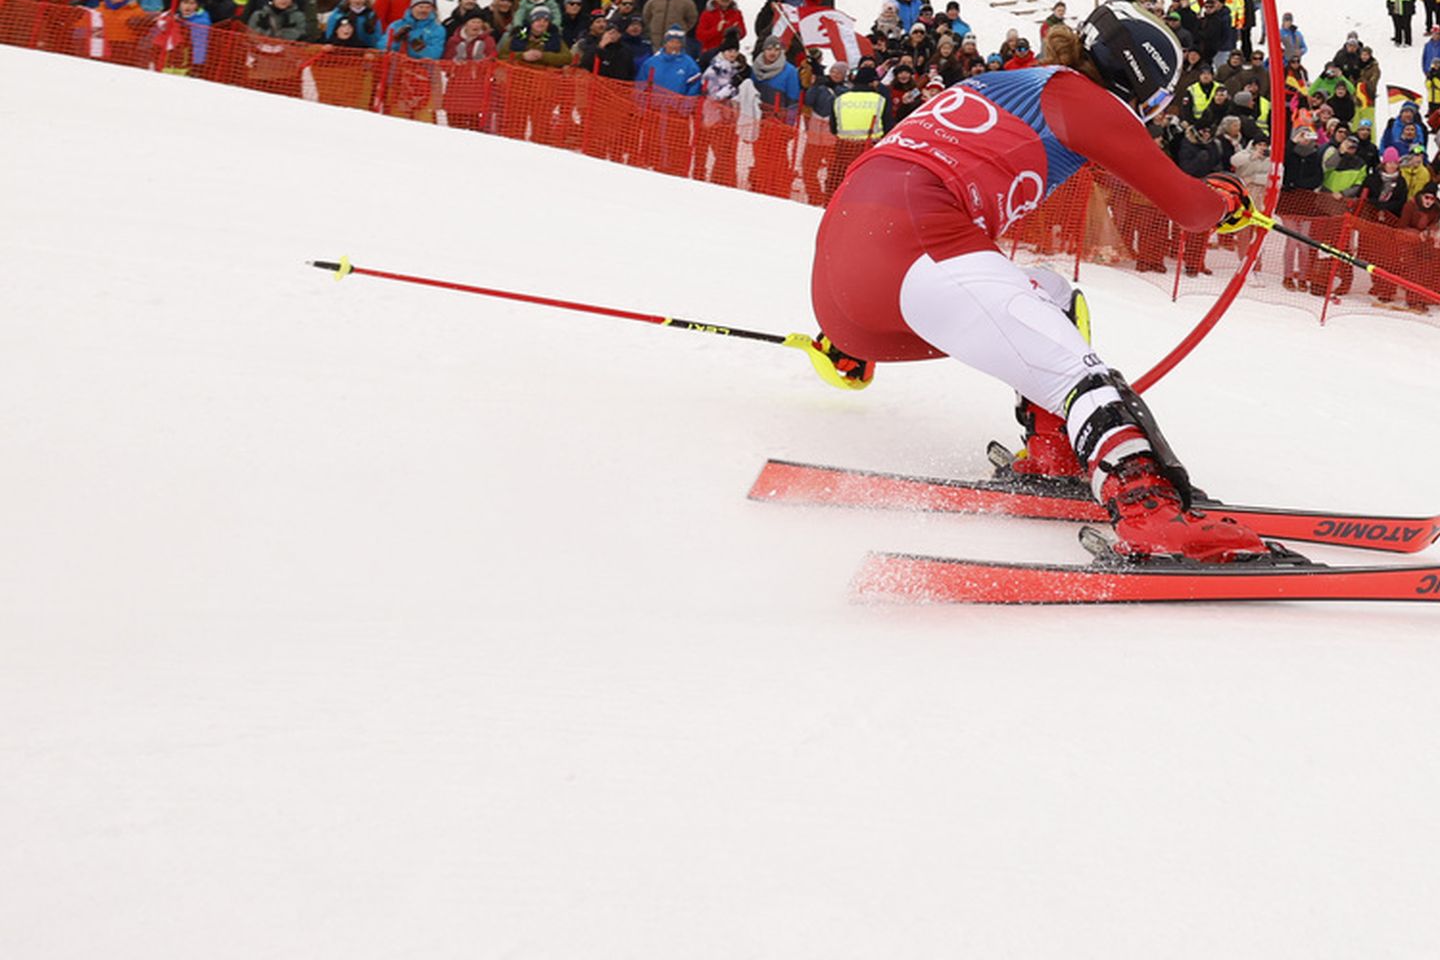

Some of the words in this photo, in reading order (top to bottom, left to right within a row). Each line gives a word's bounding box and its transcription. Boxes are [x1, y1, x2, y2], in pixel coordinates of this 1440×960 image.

[1123, 49, 1146, 83] ATOMIC
[1142, 41, 1171, 75] ATOMIC
[1312, 520, 1425, 542] ATOMIC
